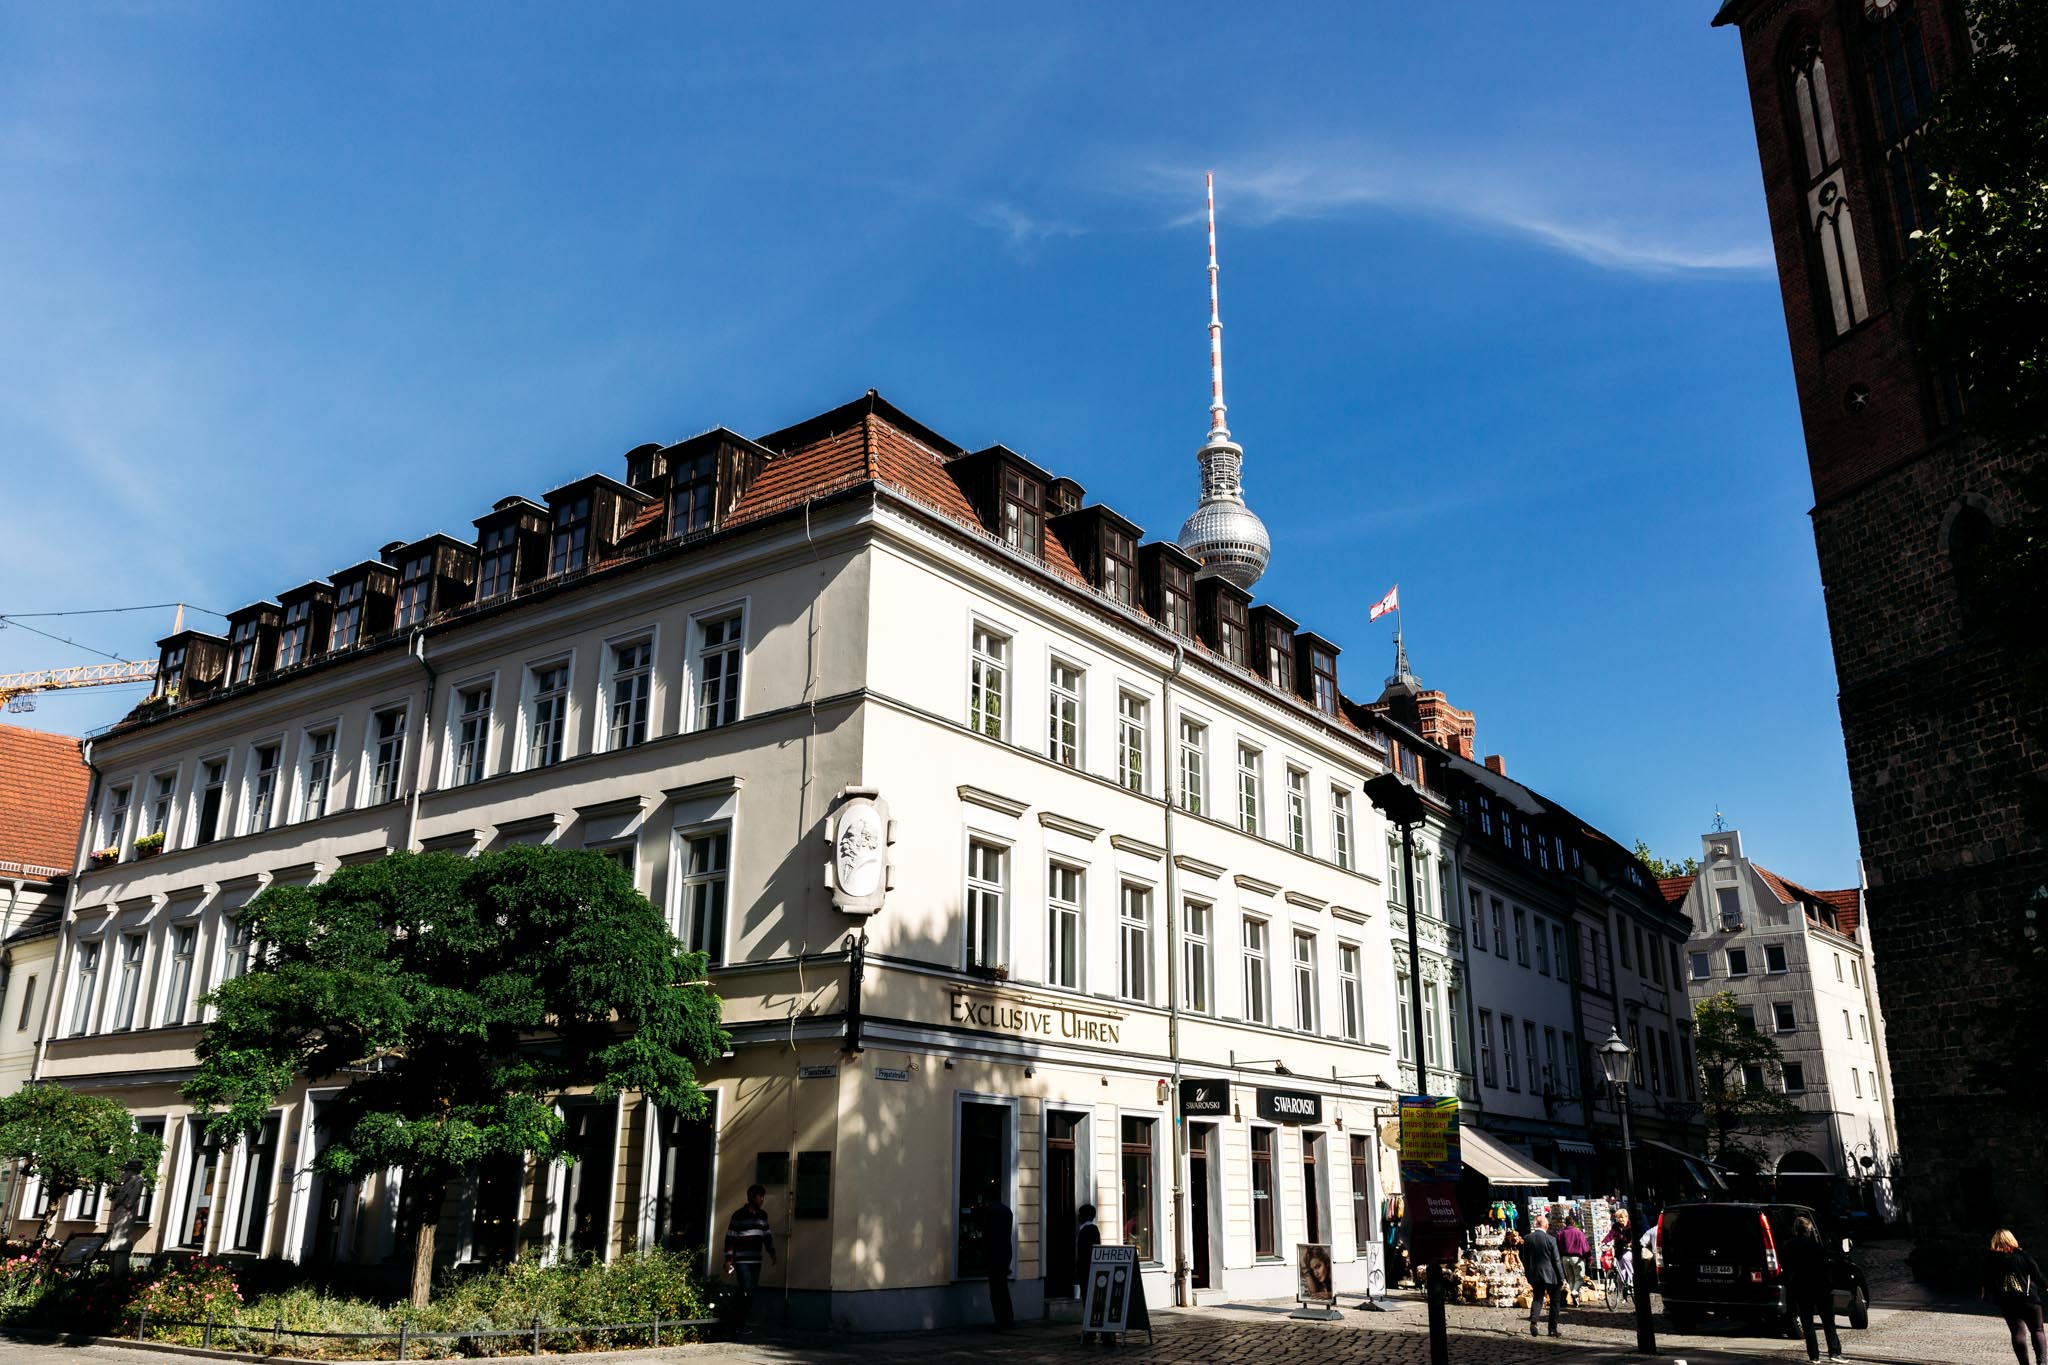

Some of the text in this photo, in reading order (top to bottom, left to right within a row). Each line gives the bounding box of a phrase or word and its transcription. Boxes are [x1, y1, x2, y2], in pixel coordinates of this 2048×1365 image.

[1060, 1008, 1121, 1044] UHREN
[1186, 1101, 1220, 1110] SWAROVSKI
[1274, 1096, 1315, 1116] SWAROVSKI
[1404, 1109, 1450, 1119] Die Sicherheit
[1424, 1120, 1446, 1129] besser
[1404, 1131, 1441, 1140] organisiert
[1427, 1197, 1451, 1206] Berlin
[1429, 1207, 1455, 1216] bleibt
[1094, 1249, 1132, 1261] UHREN
